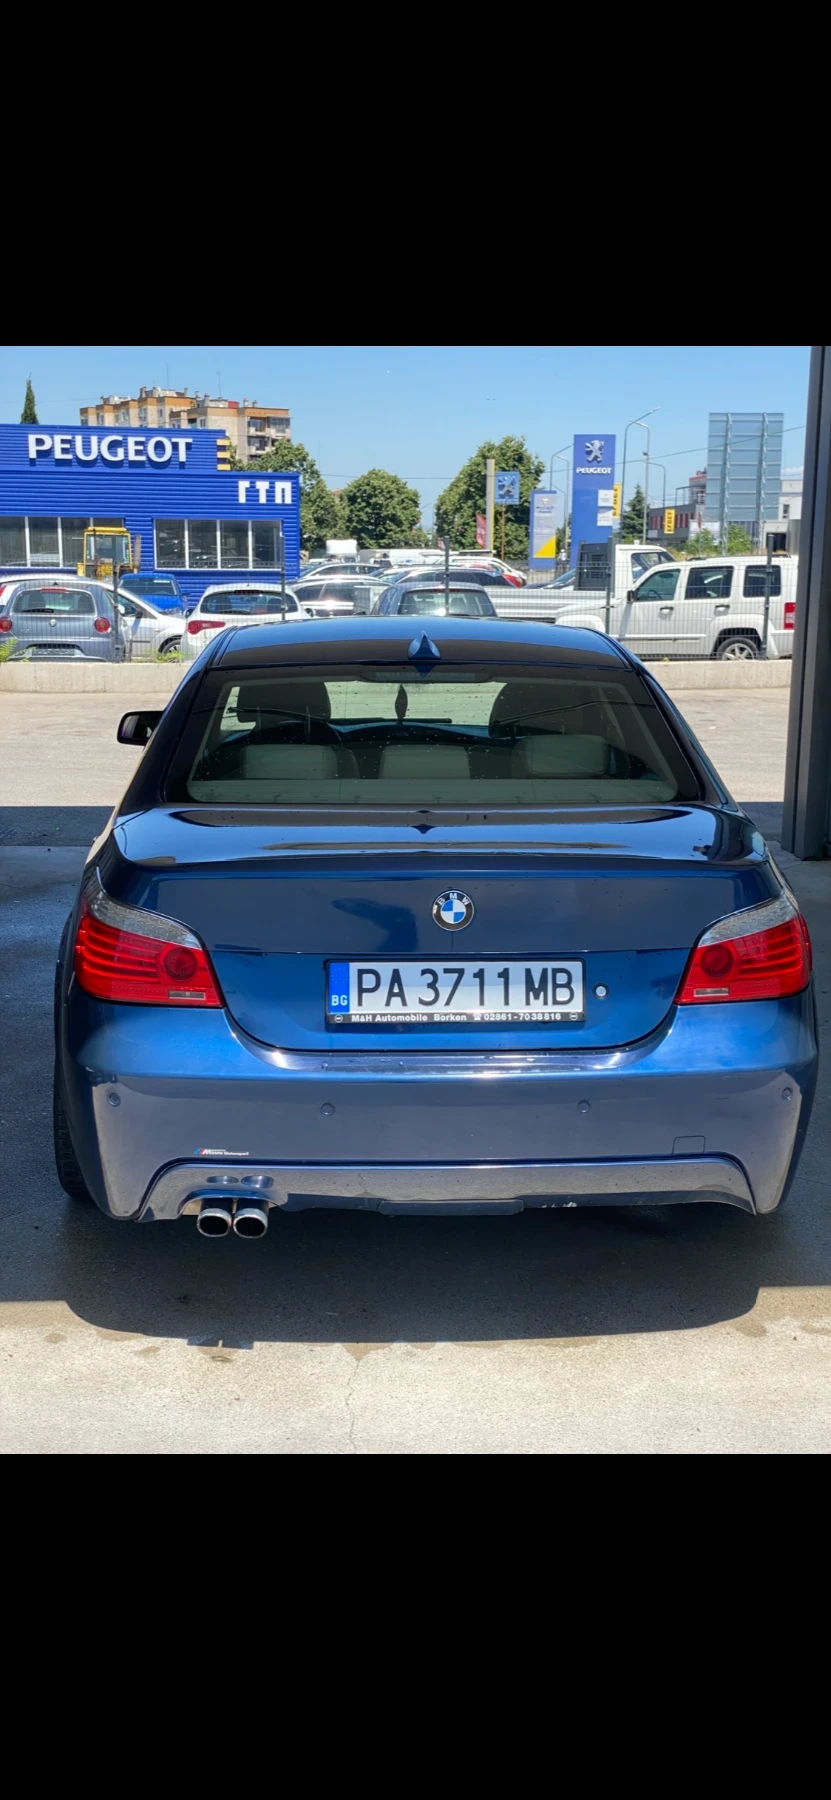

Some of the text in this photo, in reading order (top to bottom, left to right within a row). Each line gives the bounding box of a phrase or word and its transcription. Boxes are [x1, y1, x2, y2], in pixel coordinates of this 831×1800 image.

[28, 434, 193, 463] PEUGEOT
[576, 466, 612, 474] PEUGEOT
[238, 480, 292, 504] ГТП
[437, 892, 471, 905] BMW
[418, 967, 510, 1007] 3711
[331, 995, 348, 1006] BG
[351, 1014, 372, 1022] M&H
[375, 1013, 428, 1022] Automobile
[433, 1013, 467, 1021] Borken
